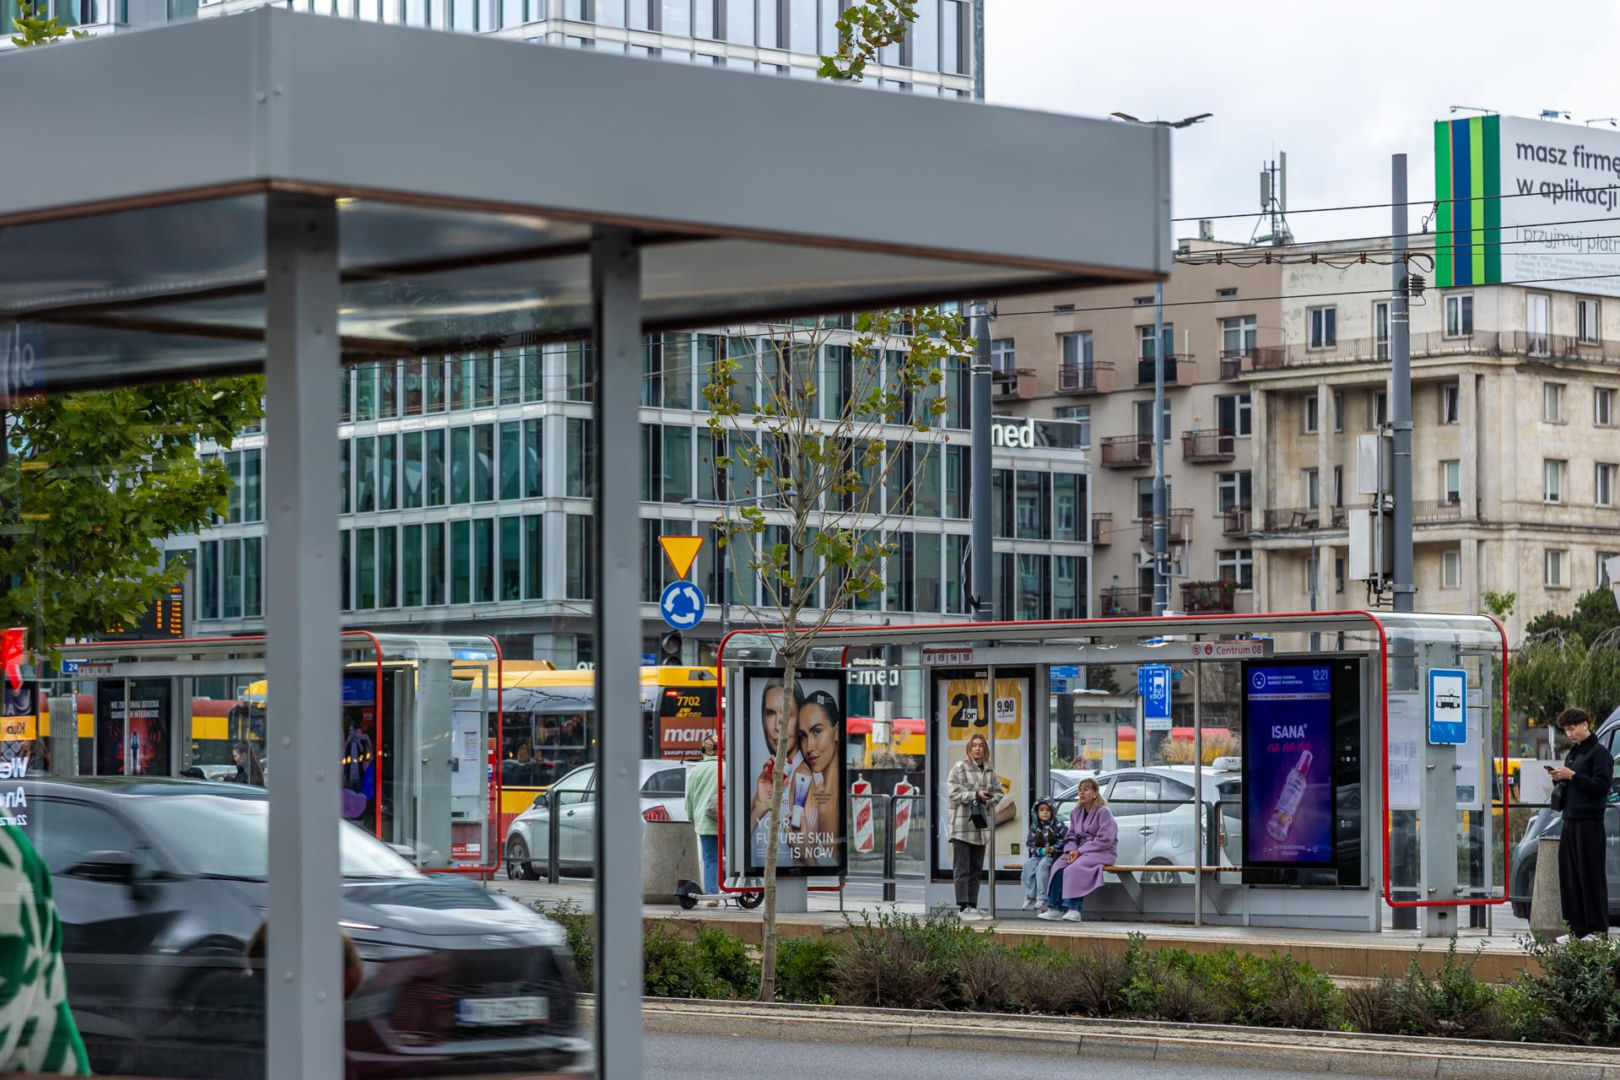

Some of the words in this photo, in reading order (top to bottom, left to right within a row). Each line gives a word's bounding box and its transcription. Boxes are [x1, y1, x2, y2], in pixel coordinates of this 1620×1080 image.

[1516, 142, 1567, 166] masz
[1516, 178, 1534, 194] w
[1539, 179, 1618, 211] aplikacji
[1523, 228, 1583, 252] przyjmuj
[1216, 645, 1250, 655] Centrum
[938, 653, 945, 661] 15
[677, 696, 701, 706] 7702
[997, 700, 1014, 714] 9,90
[1272, 725, 1305, 739] ISANA
[756, 817, 790, 829] YOR
[756, 832, 804, 844] FUURE
[807, 831, 835, 844] SKIN
[790, 846, 801, 859] IS
[805, 846, 834, 859] NOW
